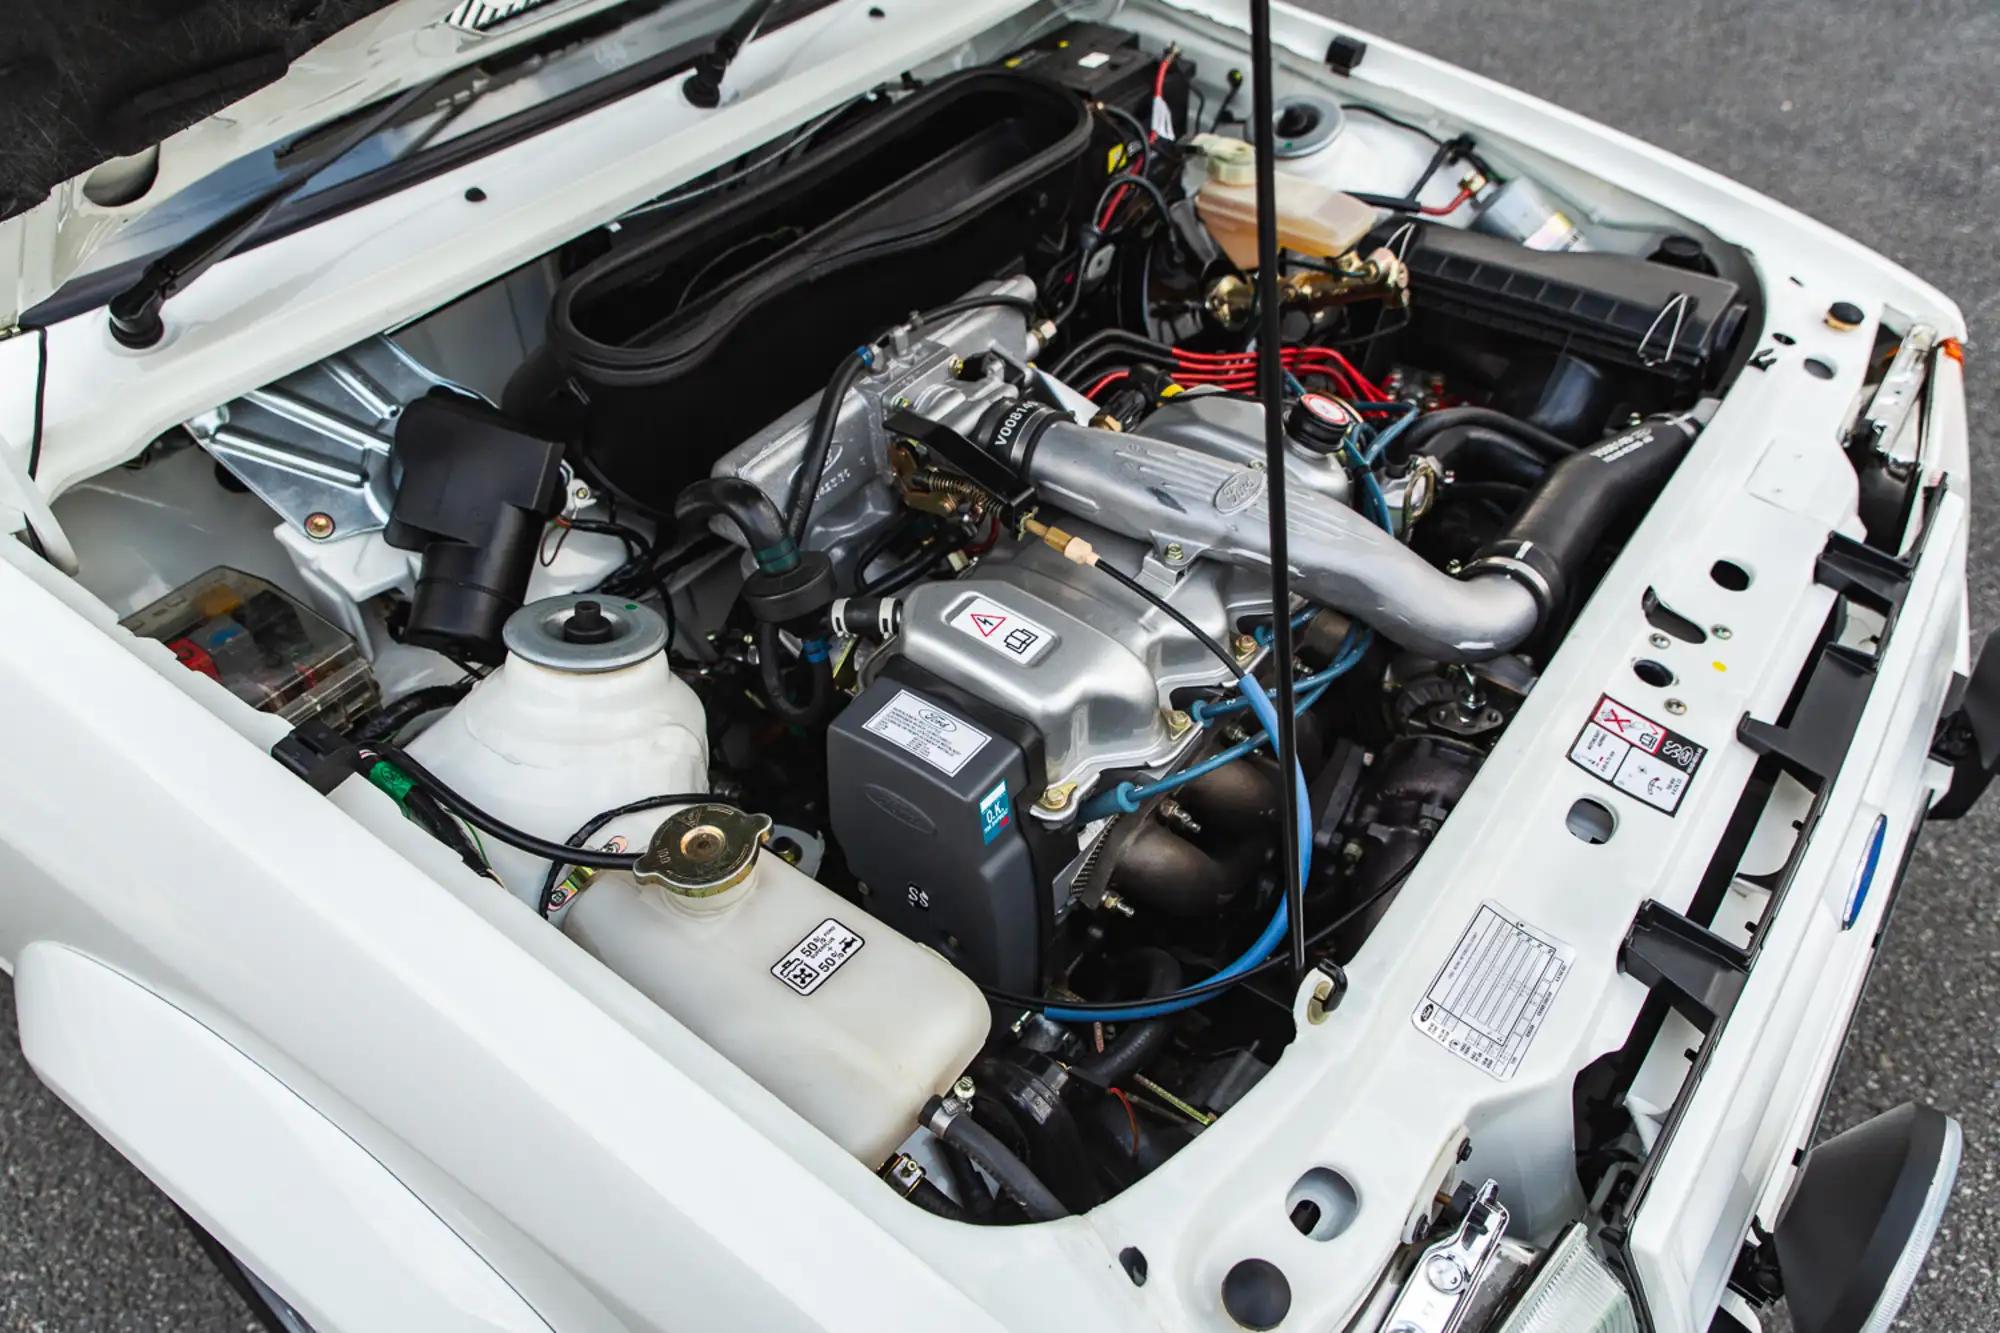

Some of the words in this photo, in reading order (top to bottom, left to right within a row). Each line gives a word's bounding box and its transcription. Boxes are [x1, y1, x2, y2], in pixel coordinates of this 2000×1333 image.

[1223, 475, 1260, 508] Ford
[1662, 740, 1681, 758] SS
[800, 936, 827, 957] 50%
[823, 926, 836, 937] FORD
[810, 937, 836, 959] SUPERPLUS
[818, 950, 845, 973] 50%
